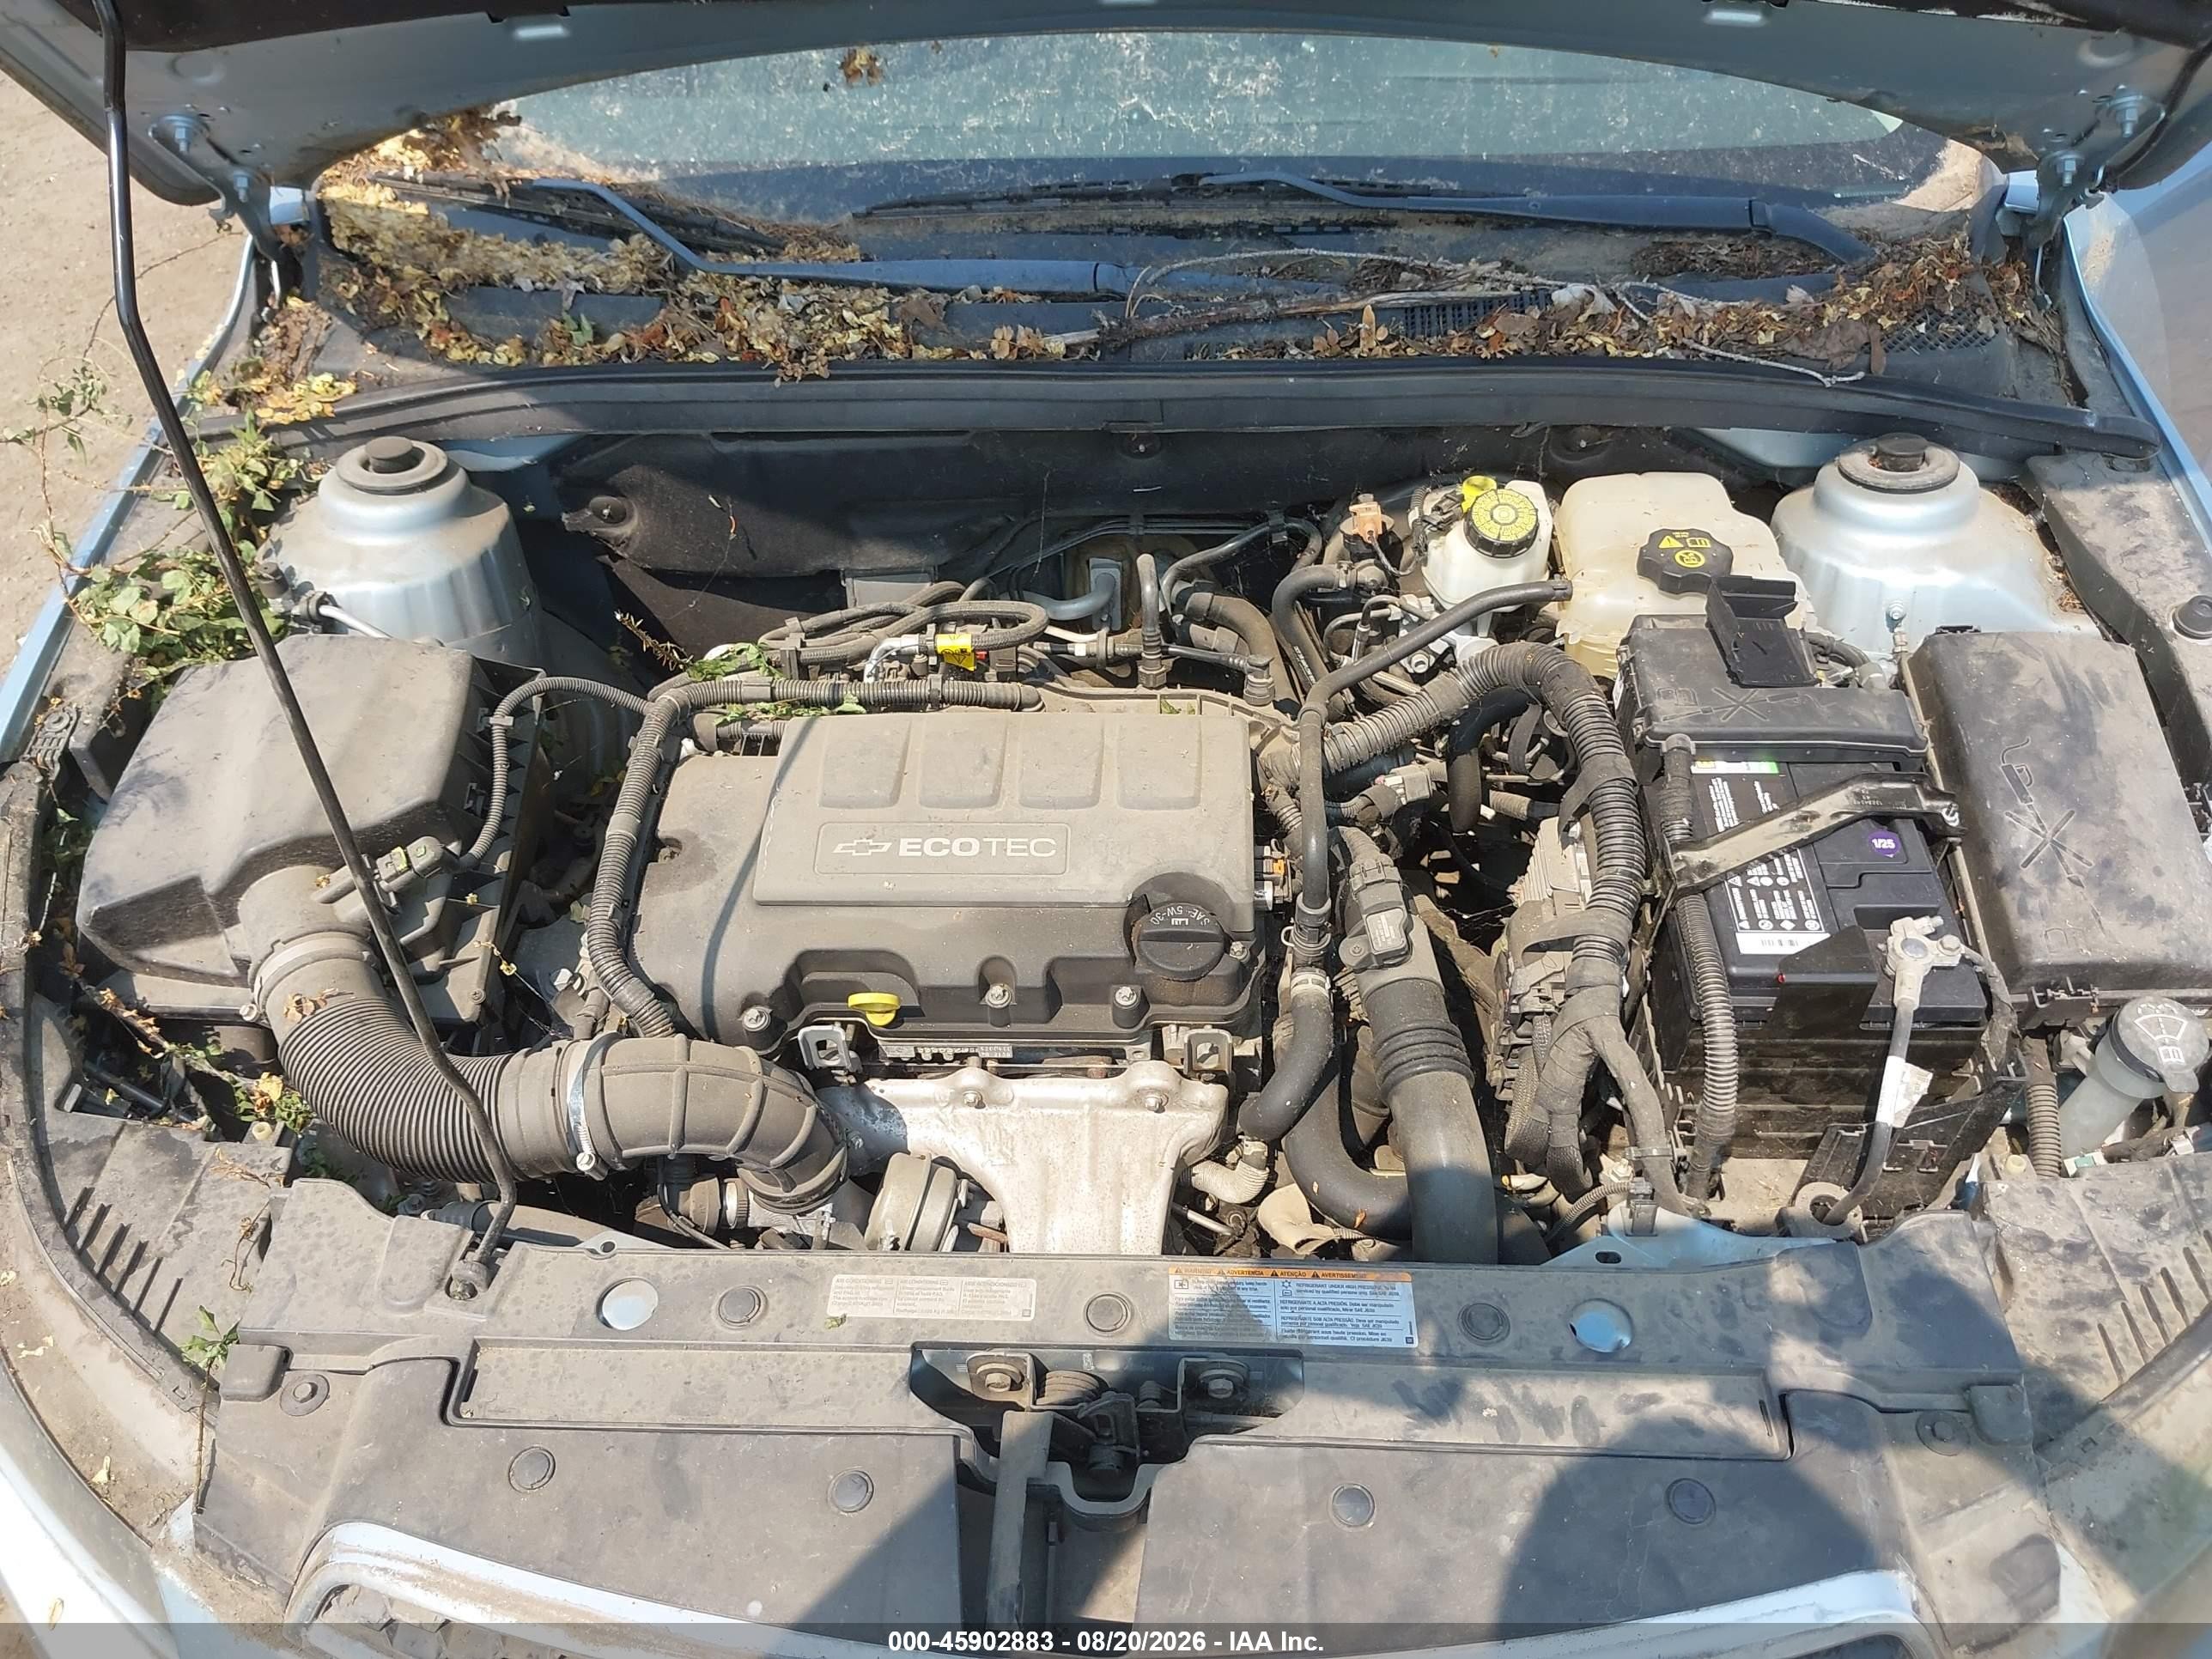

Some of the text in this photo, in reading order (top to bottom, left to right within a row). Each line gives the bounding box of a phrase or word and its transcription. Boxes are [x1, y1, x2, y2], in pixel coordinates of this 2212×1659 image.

[899, 837, 1056, 857] ECOTEC
[1871, 837, 1896, 849] 1/25
[1150, 905, 1210, 926] SAE 5W-30
